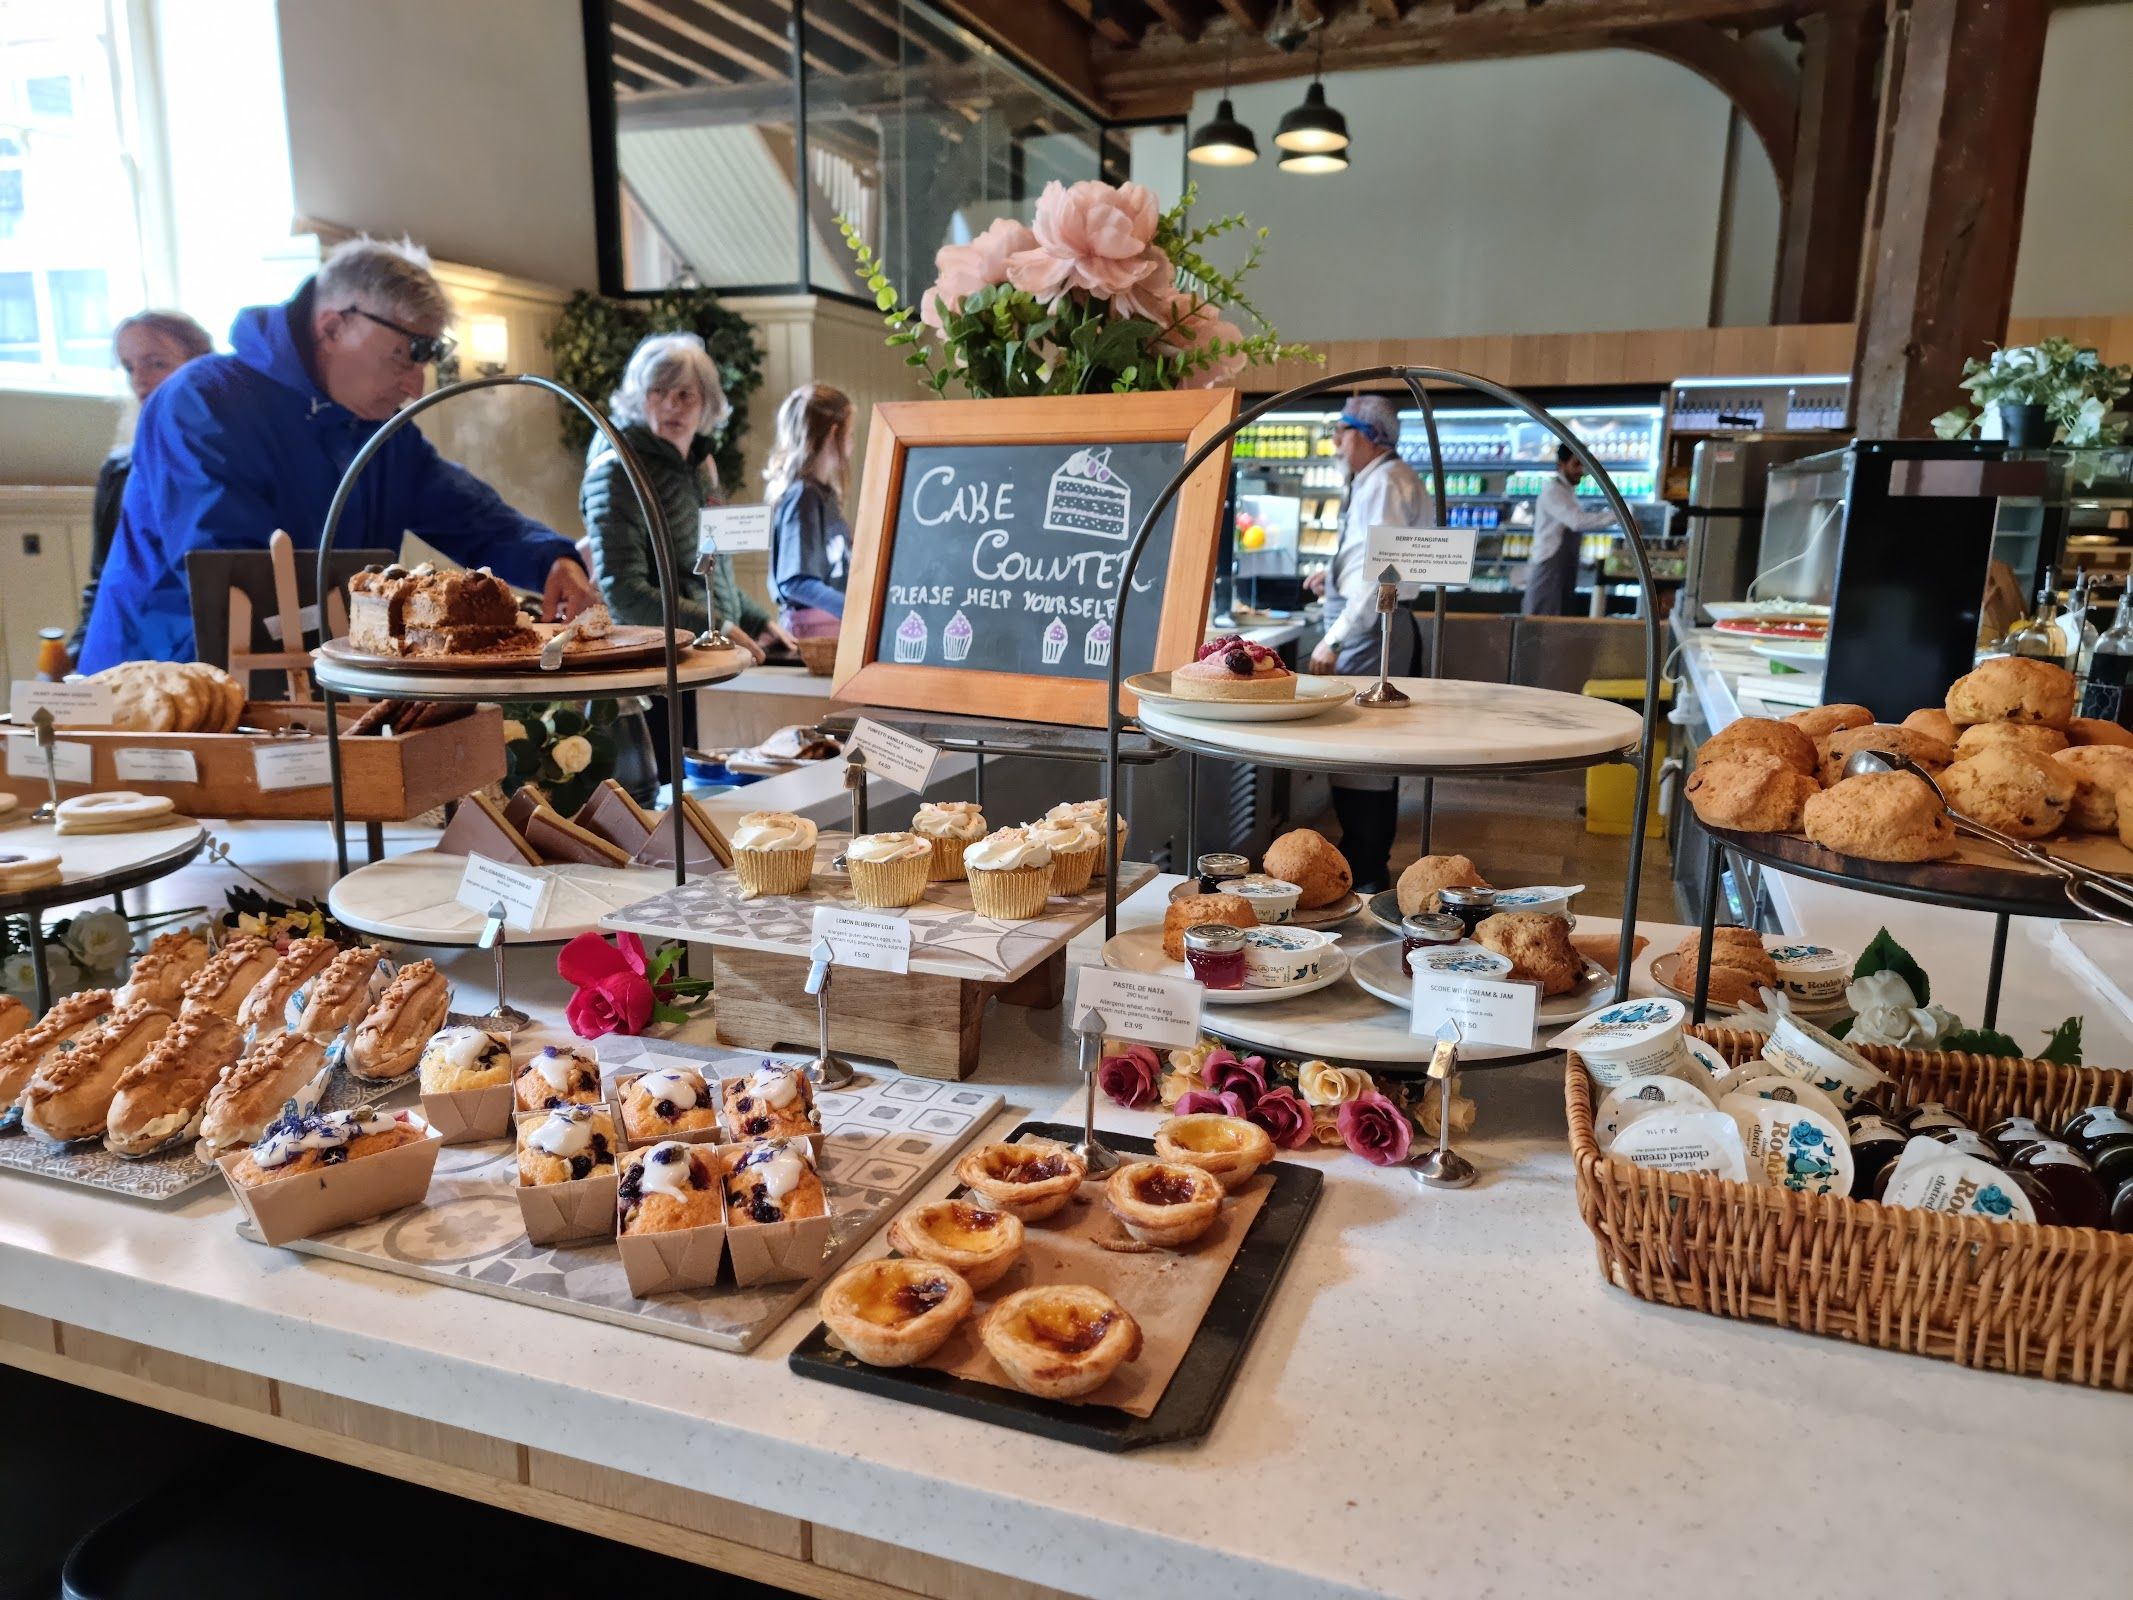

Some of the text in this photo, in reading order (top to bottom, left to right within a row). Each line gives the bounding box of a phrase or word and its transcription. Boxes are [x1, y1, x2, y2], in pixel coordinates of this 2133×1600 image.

[913, 466, 1015, 526] CAKE
[890, 586, 1115, 620] PLEASE HELP YOURSELF
[887, 734, 904, 746] VANILLA
[904, 741, 924, 754] CUPCAKE
[878, 761, 891, 770] £4.50
[506, 875, 532, 891] SHORTBREAD
[1112, 981, 1136, 991] PASTEL
[1147, 986, 1165, 995] NATA
[1430, 984, 1451, 993] SCONE
[1468, 988, 1492, 998] CREAM
[1137, 993, 1149, 1001] kcal
[1100, 999, 1126, 1008] Allergens:
[1126, 1002, 1143, 1011] wheat,
[1113, 1008, 1127, 1016] nuts,
[1128, 1010, 1150, 1020] peanuts,
[1151, 1014, 1164, 1022] soya
[1170, 1017, 1191, 1026] sesame
[1124, 1021, 1143, 1030] £3.95
[1751, 1124, 1763, 1158] clotted
[1631, 1150, 1709, 1162] clotted cream
[1924, 1175, 1946, 1211] clotted
